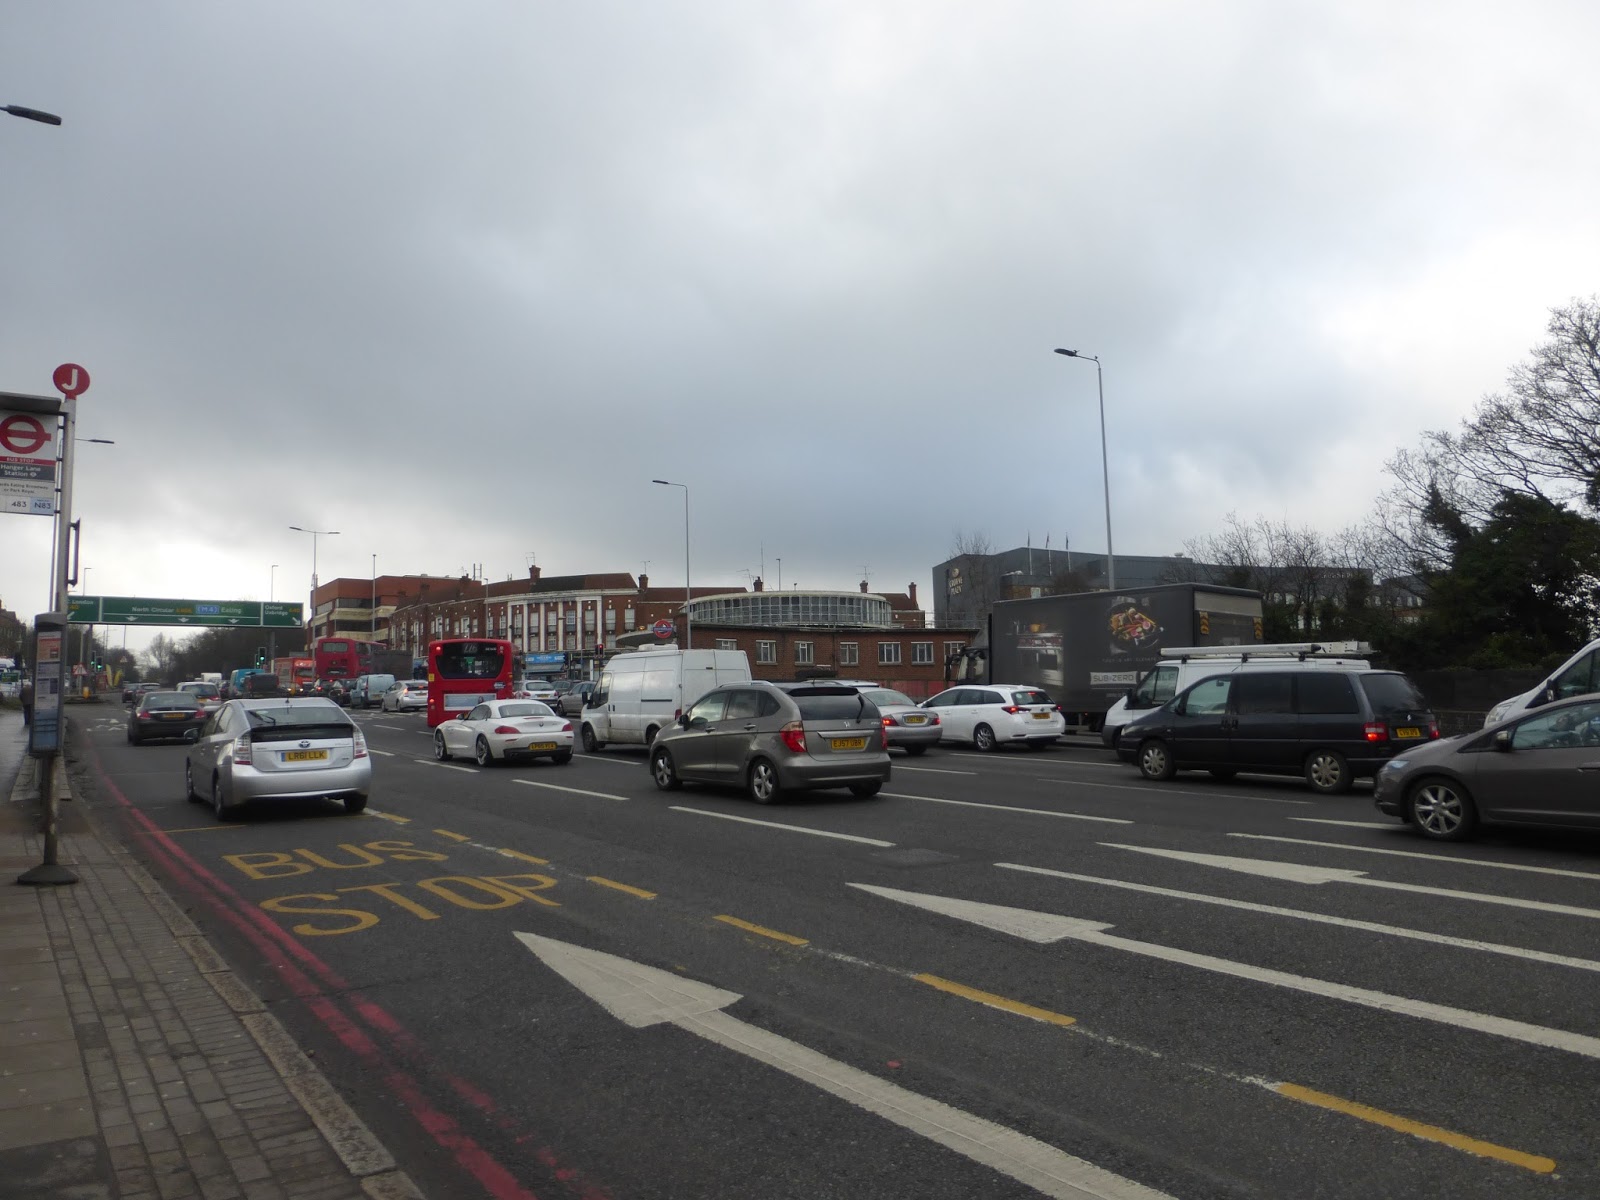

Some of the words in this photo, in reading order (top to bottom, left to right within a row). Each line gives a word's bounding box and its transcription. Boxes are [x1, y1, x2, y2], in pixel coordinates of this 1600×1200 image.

[61, 368, 78, 390] J
[221, 606, 242, 614] Ealing
[833, 739, 849, 748] EJ57
[288, 751, 307, 760] LR61
[309, 750, 325, 759] LLK
[222, 840, 450, 880] BUS
[259, 873, 562, 936] STOP
